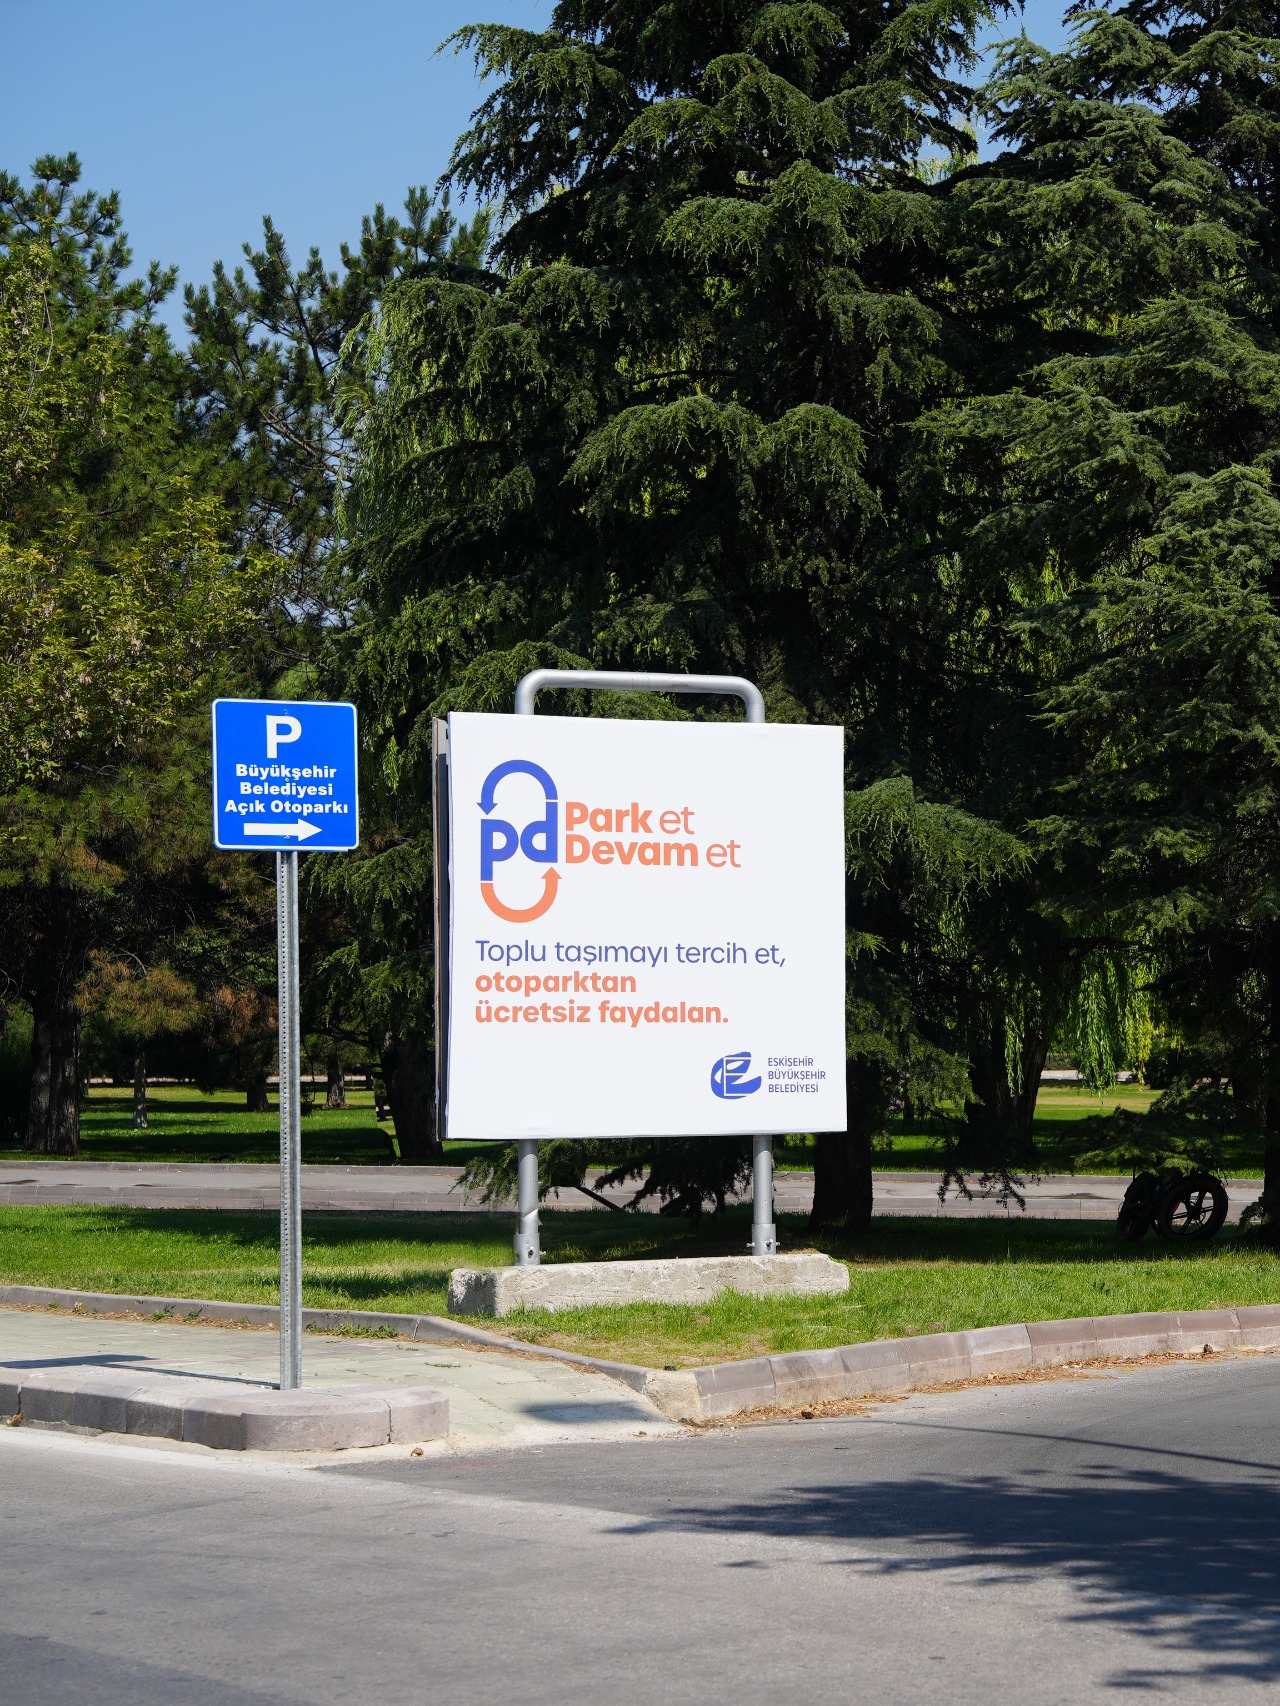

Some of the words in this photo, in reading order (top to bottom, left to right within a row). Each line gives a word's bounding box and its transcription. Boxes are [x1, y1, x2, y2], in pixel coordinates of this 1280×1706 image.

[266, 715, 302, 758] P
[236, 764, 337, 780] Büyükşehir
[240, 782, 333, 798] Belediyesi
[225, 800, 266, 815] Açık
[271, 800, 348, 816] Otoparkı
[566, 802, 653, 833] Park
[660, 806, 694, 834] et
[566, 834, 698, 866] Devam
[706, 839, 741, 868] et
[476, 940, 546, 966] Toplu
[555, 941, 668, 967] taşımayı
[676, 942, 747, 964] tercih
[755, 944, 786, 968] et,
[475, 970, 637, 997] otoparktan
[475, 1000, 590, 1023] ücretsiz
[599, 1000, 729, 1028] faydalan.
[768, 1056, 813, 1067] ESKİŞEHİR
[768, 1069, 826, 1080] BÜYÜKŞEHİR
[768, 1082, 818, 1093] BELEDİYESİ
